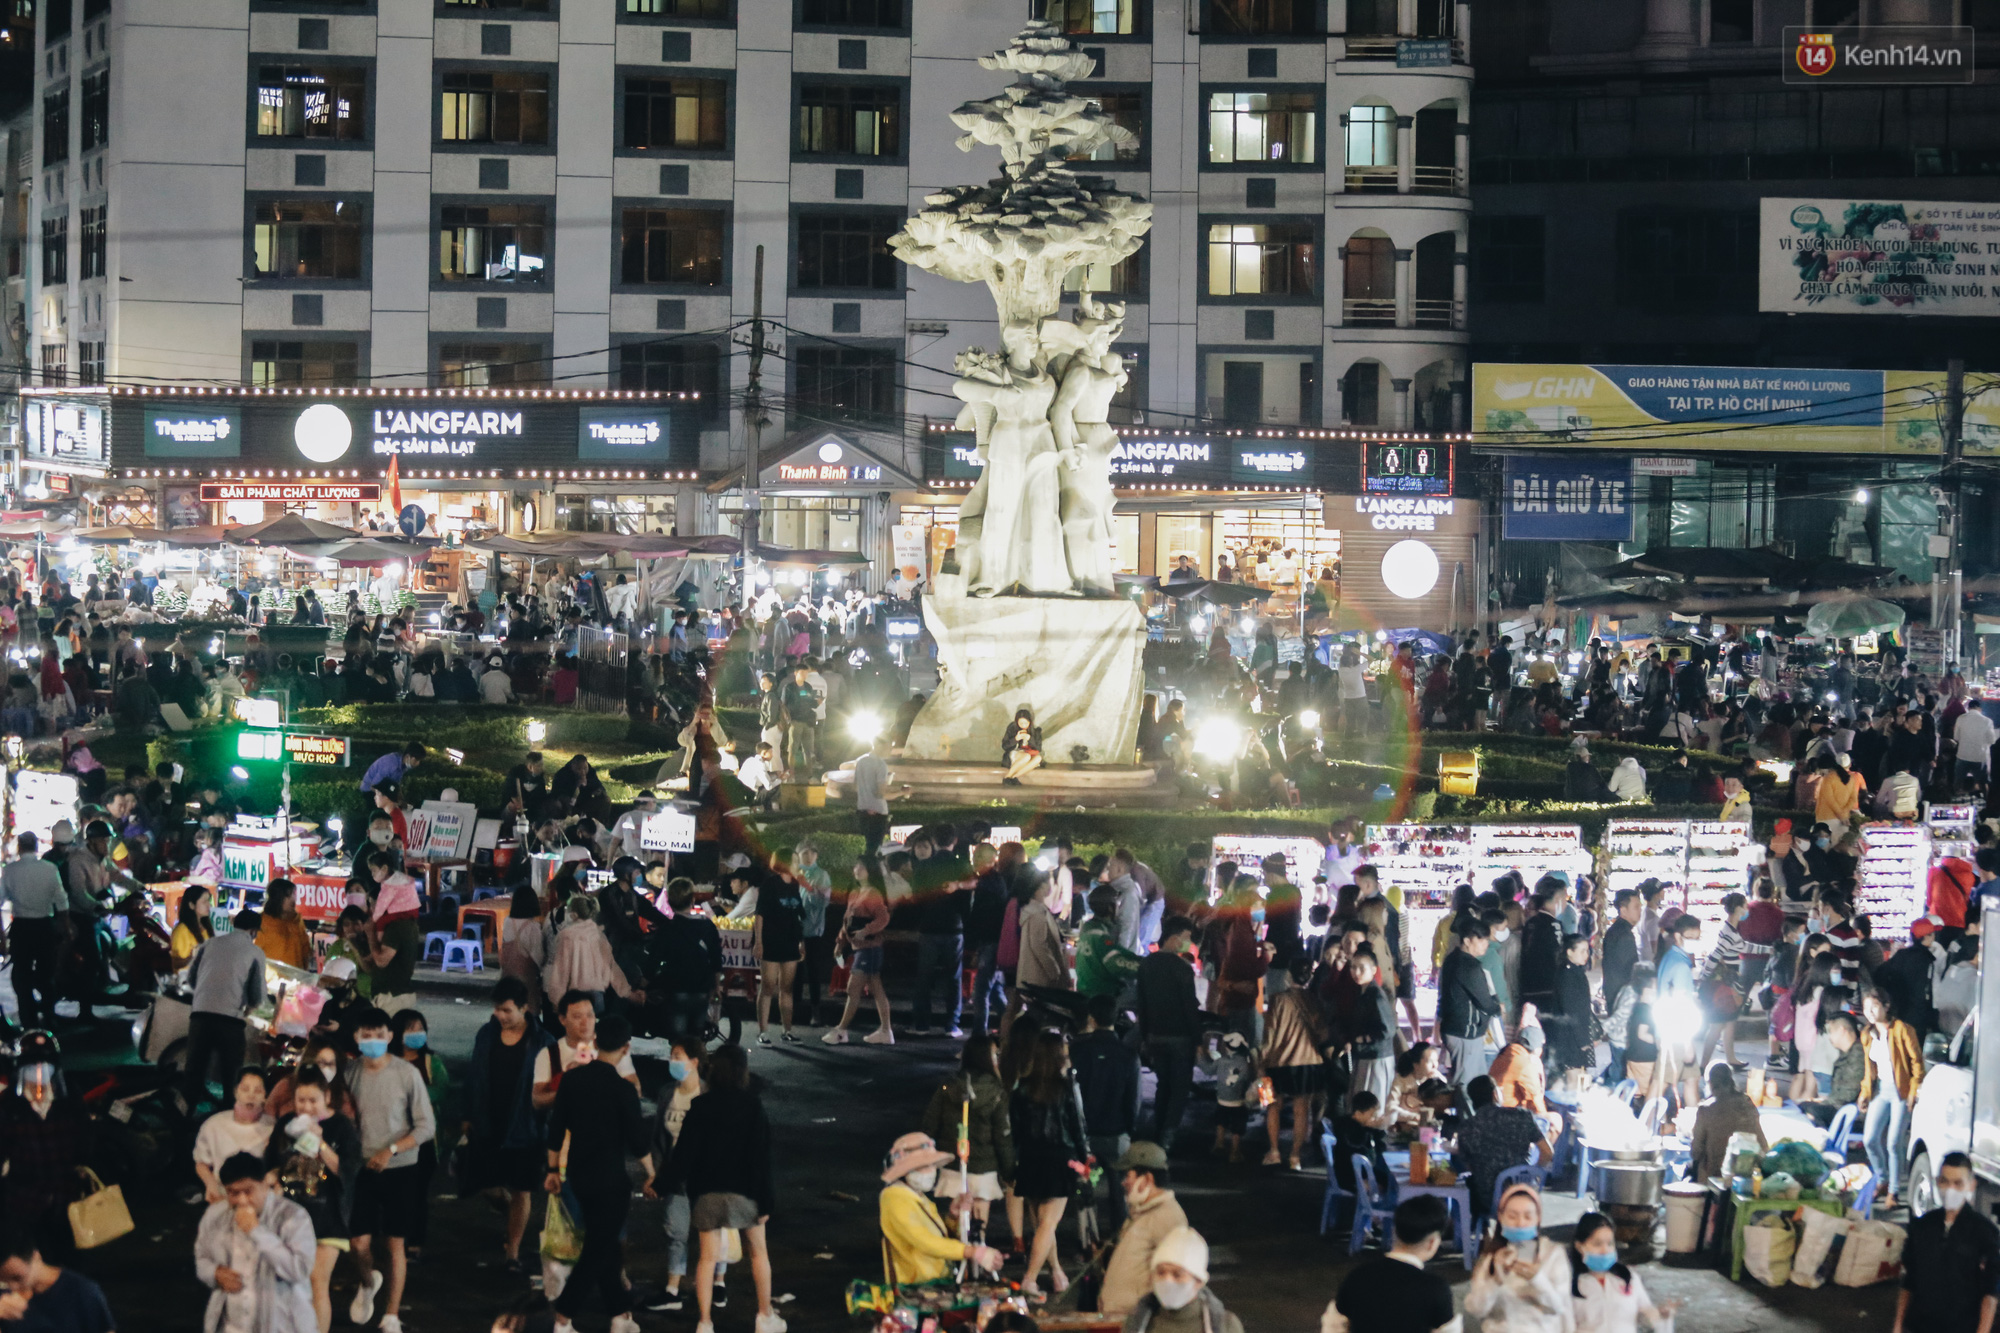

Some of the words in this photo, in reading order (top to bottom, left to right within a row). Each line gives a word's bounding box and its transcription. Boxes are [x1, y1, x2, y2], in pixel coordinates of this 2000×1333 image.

[1779, 237, 1792, 250] VÌ
[1955, 263, 1986, 276] SINH
[1867, 283, 1910, 297] TRONG
[1534, 377, 1596, 399] GHN
[1628, 378, 1656, 388] GIAO
[1658, 376, 1690, 389] HÀNG
[1691, 375, 1715, 391] TẬN
[1716, 376, 1740, 390] NHÀ
[1812, 381, 1851, 393] LƯỢNG
[1667, 396, 1691, 410] TẠI
[1695, 396, 1715, 410] TP.
[1718, 394, 1742, 411] HỒ
[1743, 395, 1769, 412] CHÍ
[1771, 399, 1812, 412] MINH
[452, 441, 476, 457] LẠT
[780, 465, 817, 480] Thanh
[820, 465, 847, 480] Bình
[318, 487, 361, 500] LƯỢNG
[1513, 473, 1549, 513] BÃI
[1556, 474, 1595, 513] GIỮ
[1597, 480, 1625, 514] XE
[1371, 514, 1435, 531] COFFEE
[293, 752, 315, 763] MỰC
[224, 856, 248, 880] KEM
